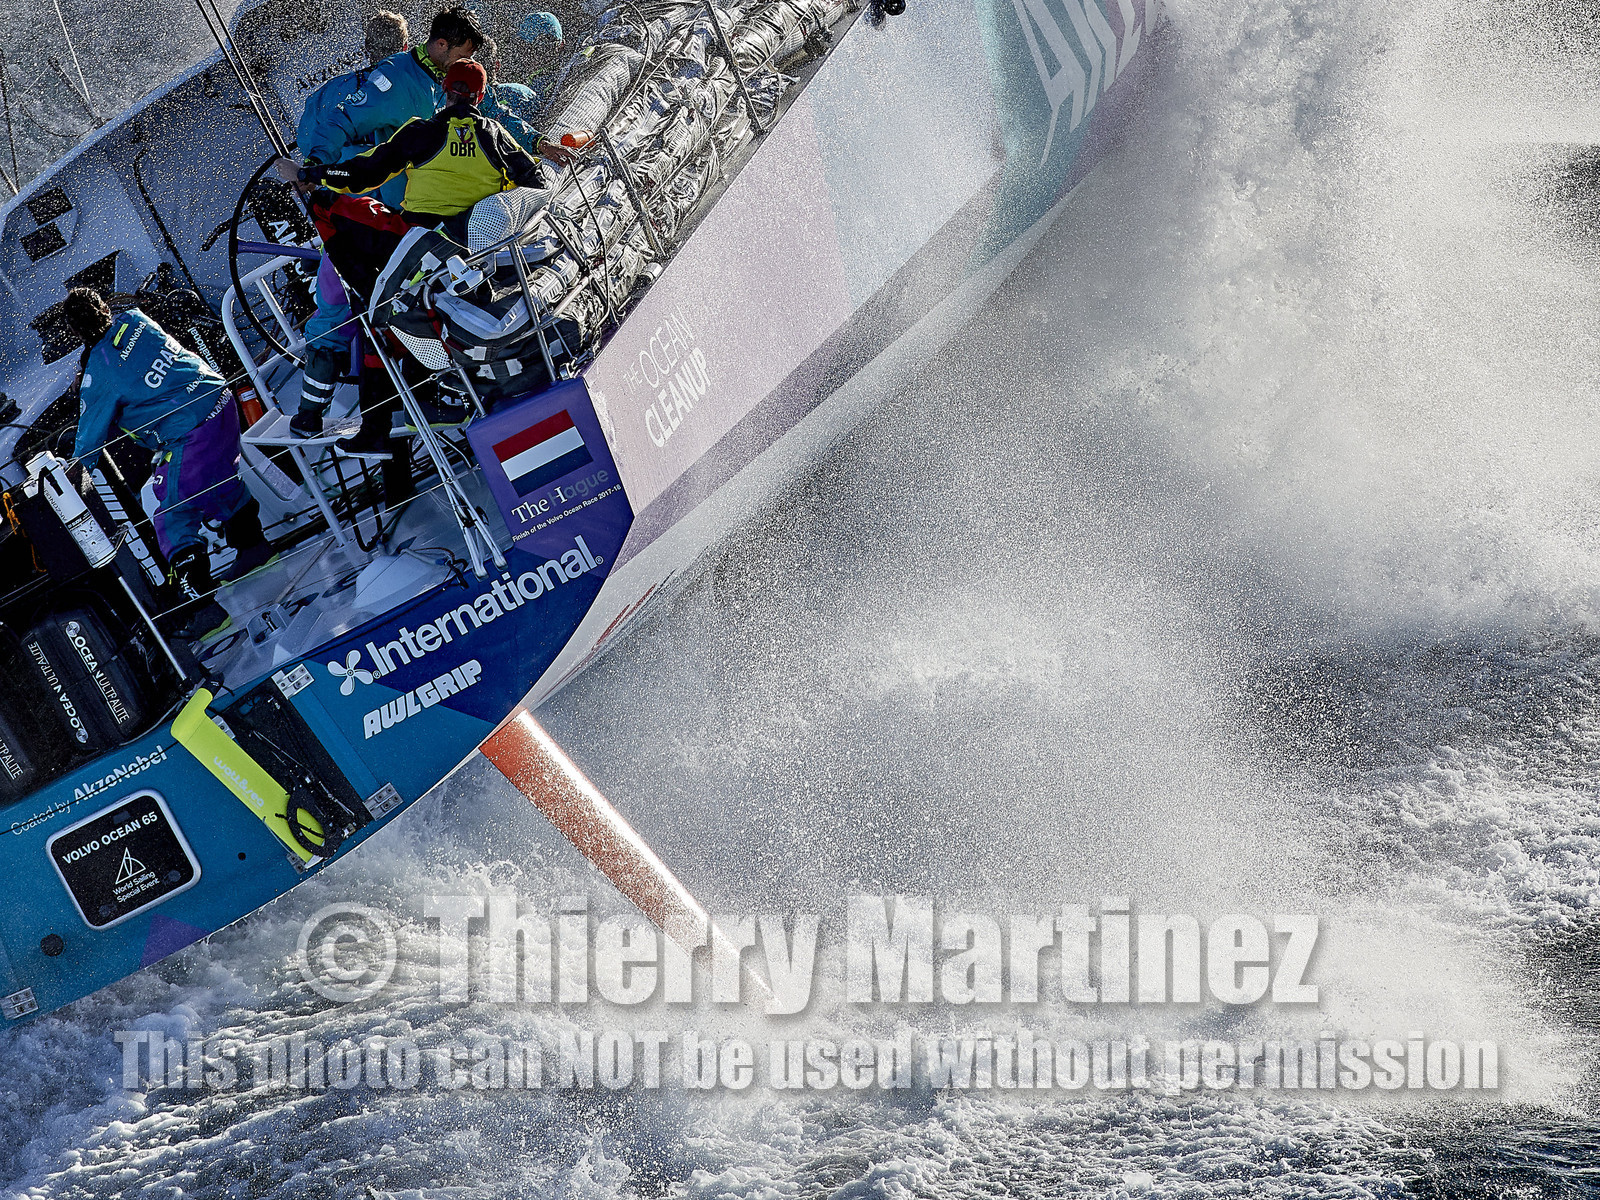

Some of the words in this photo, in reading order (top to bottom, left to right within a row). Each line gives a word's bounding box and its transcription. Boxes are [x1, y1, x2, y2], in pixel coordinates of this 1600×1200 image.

[450, 141, 477, 158] OBR
[120, 321, 147, 361] AkzoNobel
[622, 362, 643, 395] THE
[639, 302, 695, 389] OCEAN
[645, 347, 711, 448] CLEANUP
[510, 498, 550, 523] The
[512, 530, 530, 542] Finish
[530, 526, 537, 534] of
[536, 522, 547, 530] the
[546, 514, 564, 525] Volvo
[563, 504, 583, 517] Ocean
[582, 496, 598, 507] Race
[365, 535, 598, 676] International
[27, 641, 62, 689] ULTRALITE
[98, 676, 130, 724] ULTRALITE
[363, 659, 482, 740] AWLGRIP
[11, 806, 56, 836] Coated
[54, 799, 72, 814] by
[73, 745, 168, 805] AkzoNobel
[62, 840, 100, 865] VOLVO
[101, 820, 141, 846] OCEAN
[141, 811, 158, 826] 65
[112, 881, 133, 895] World
[133, 871, 156, 886] Sailing
[117, 886, 141, 903] Special
[140, 877, 160, 891] Event
